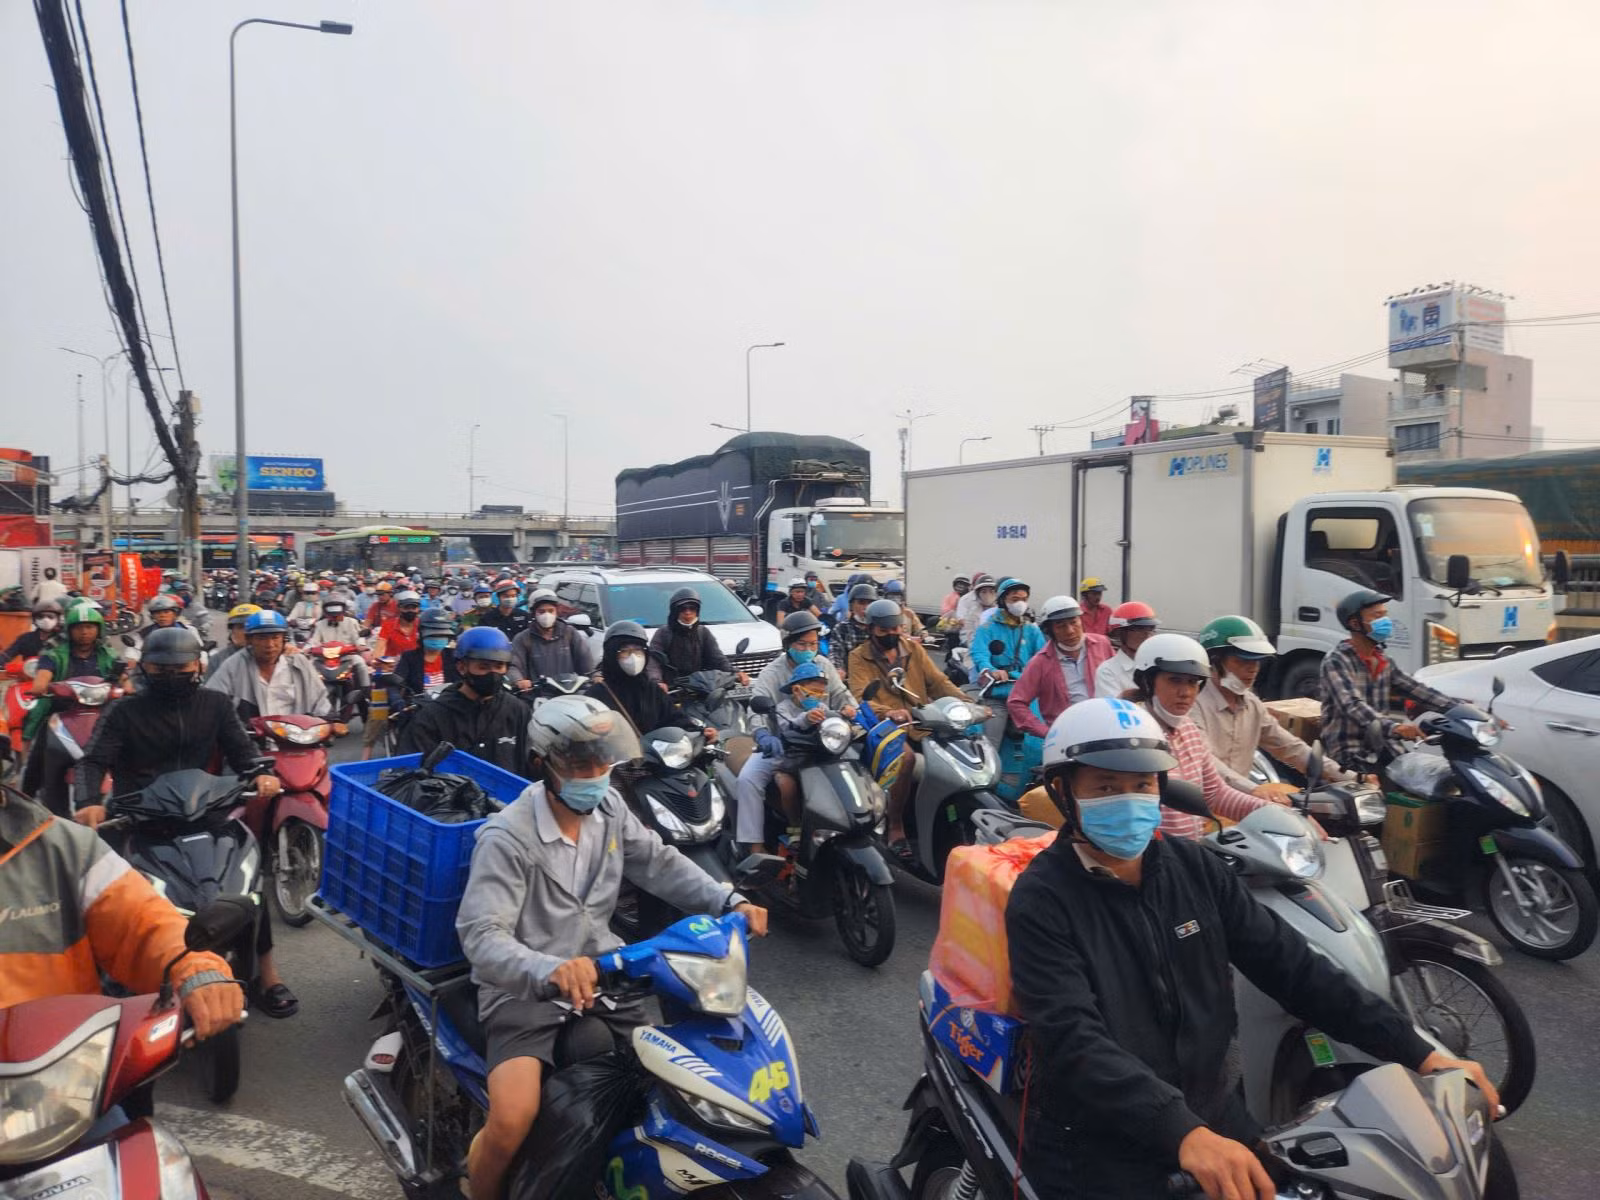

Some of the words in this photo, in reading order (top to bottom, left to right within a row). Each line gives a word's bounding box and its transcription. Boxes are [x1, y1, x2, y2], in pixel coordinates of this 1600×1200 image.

[260, 467, 317, 478] SENKO
[639, 1029, 678, 1054] YAMAHA
[948, 1020, 985, 1062] Tiger
[748, 1061, 790, 1104] 46
